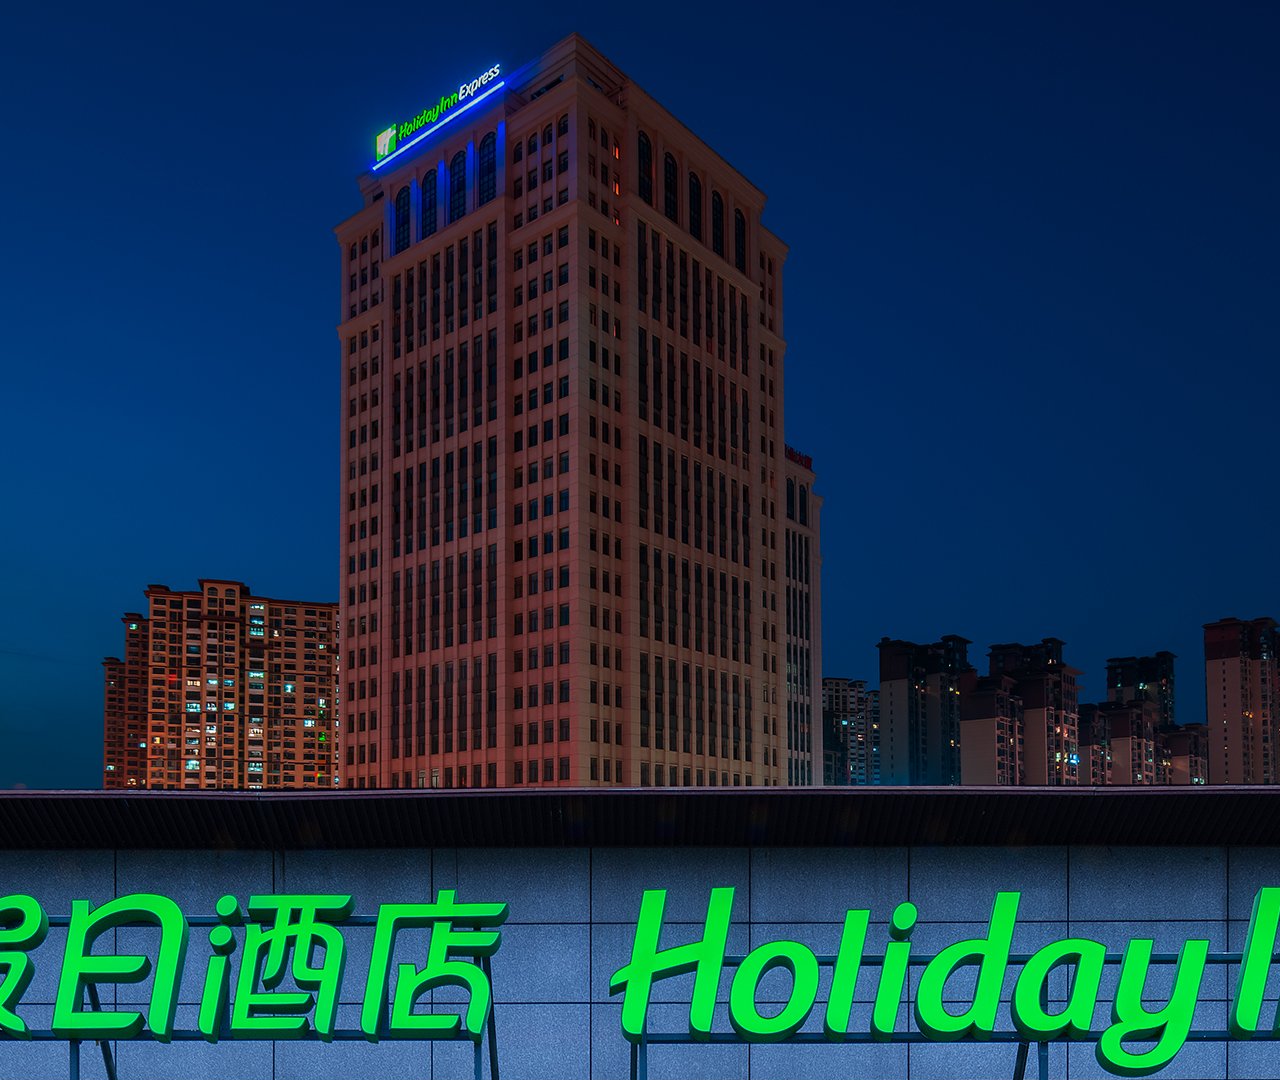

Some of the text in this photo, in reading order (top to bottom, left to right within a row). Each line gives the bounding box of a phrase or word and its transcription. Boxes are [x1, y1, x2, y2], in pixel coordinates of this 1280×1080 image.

[398, 64, 500, 141] Holiday Inn Express
[609, 887, 1210, 1070] Holiday
